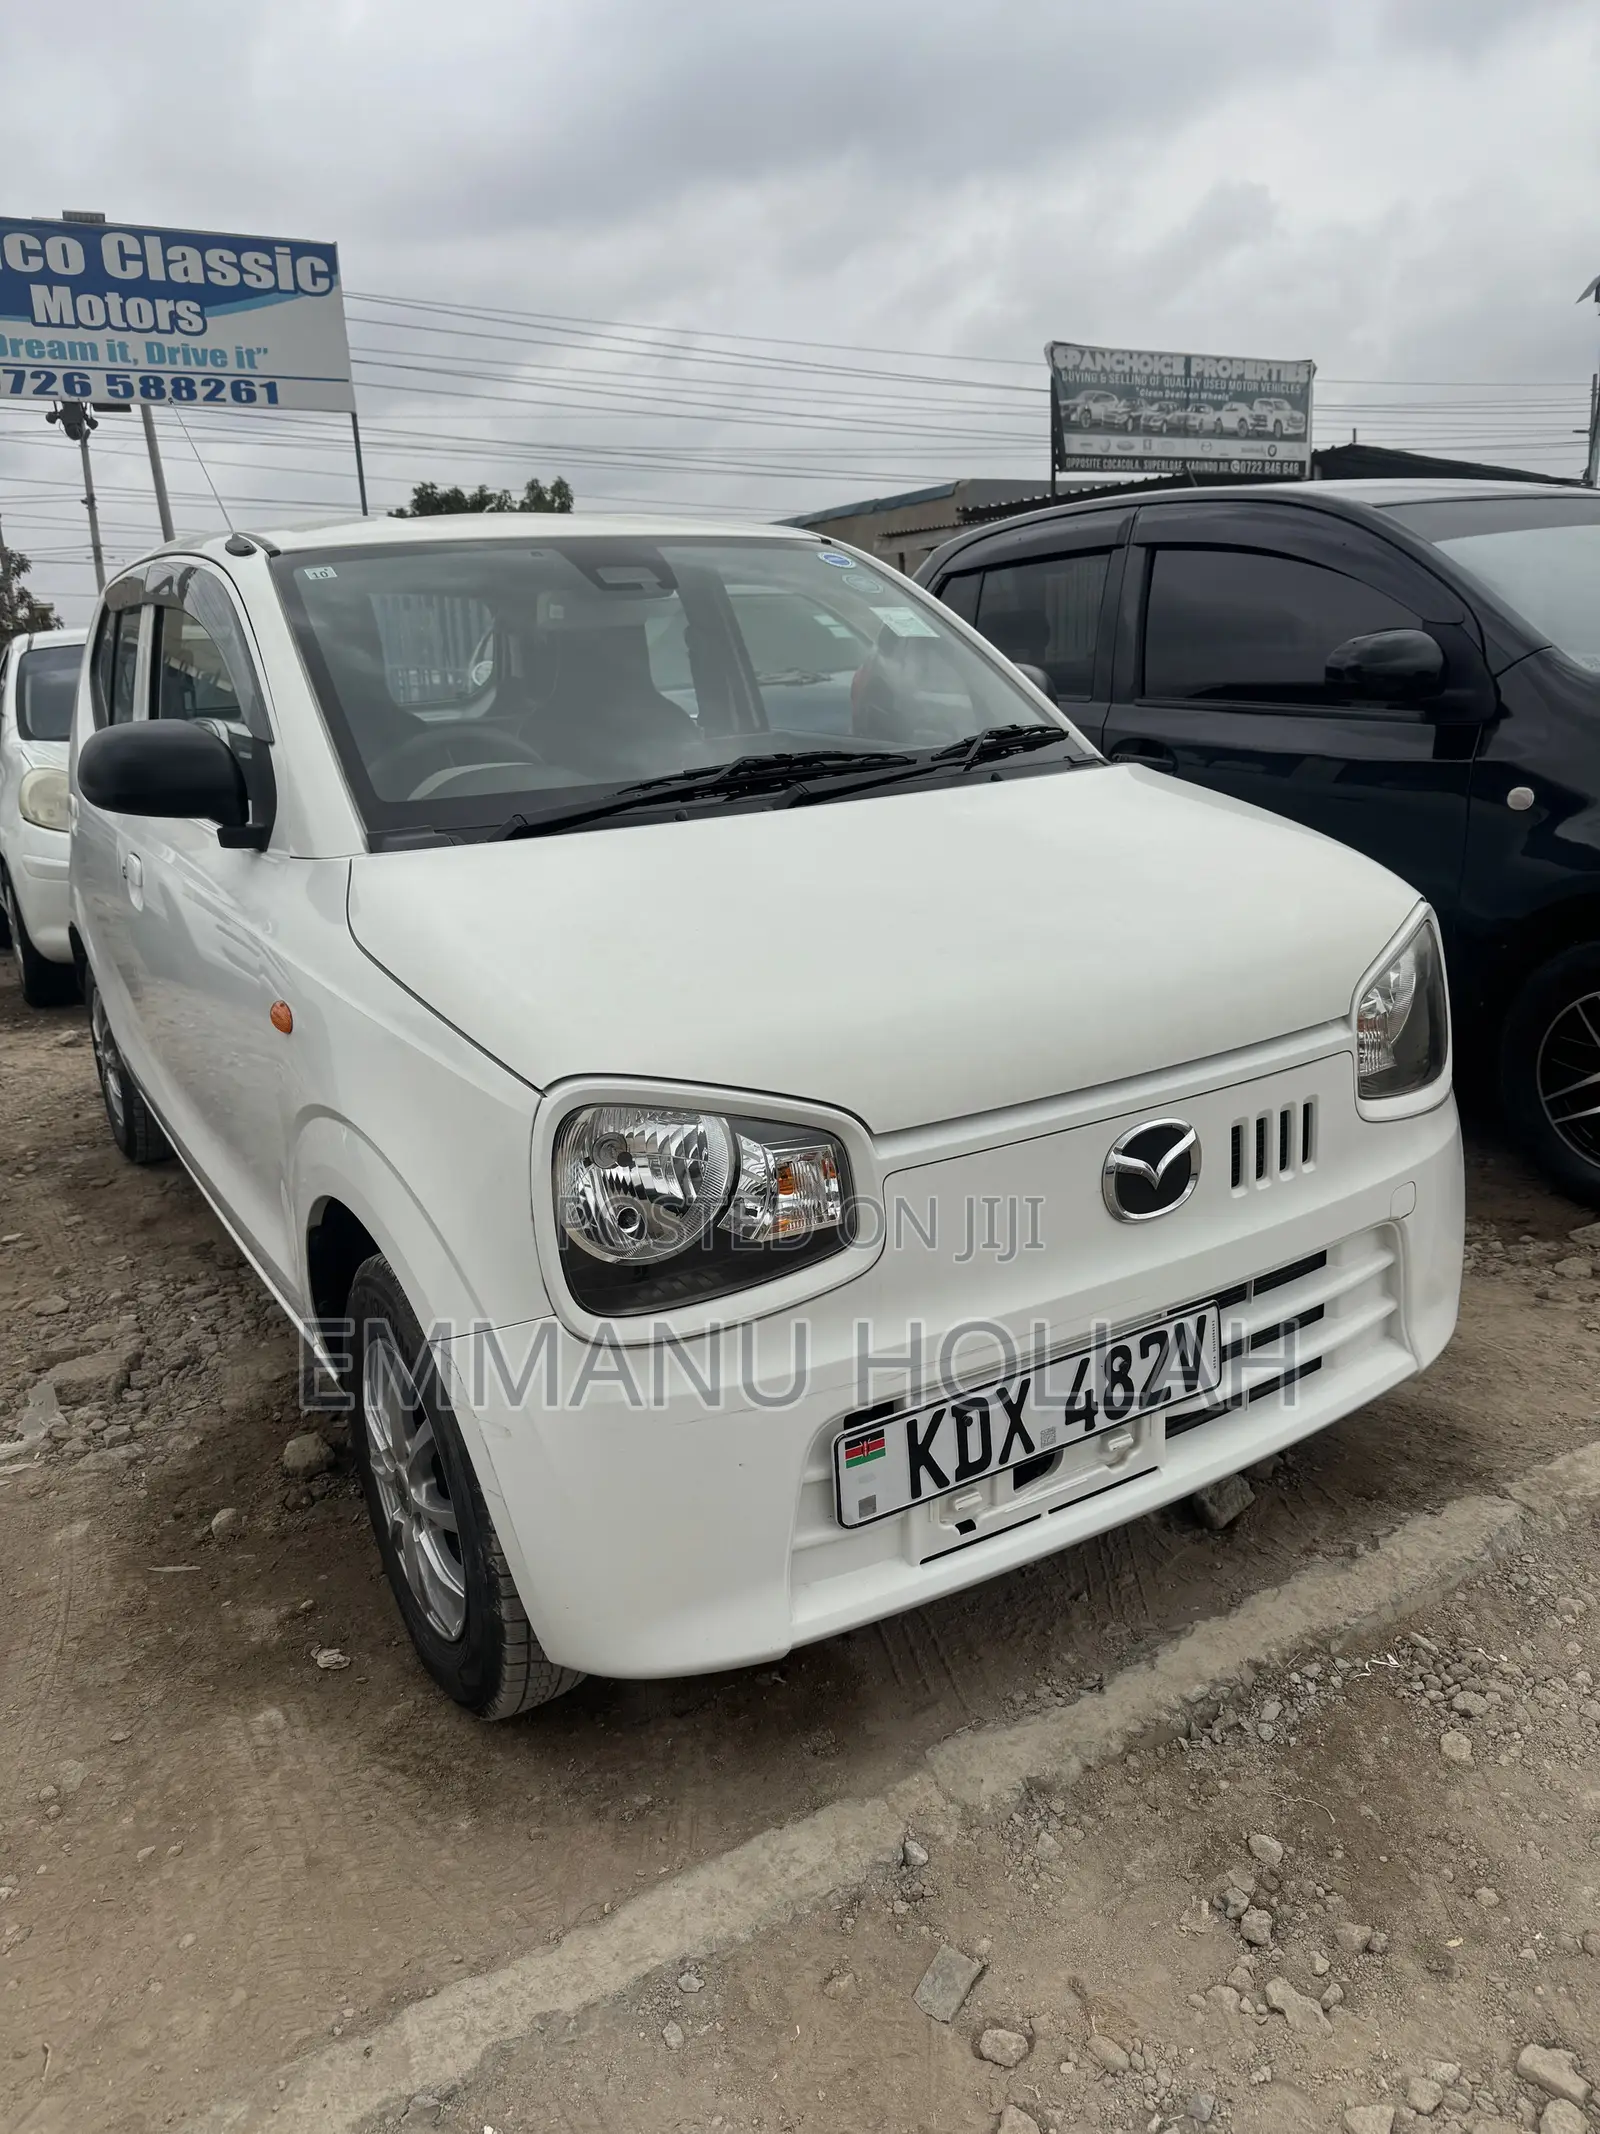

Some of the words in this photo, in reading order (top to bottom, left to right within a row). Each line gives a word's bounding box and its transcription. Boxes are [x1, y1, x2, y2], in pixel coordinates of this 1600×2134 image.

[0, 232, 86, 276] co
[101, 232, 331, 294] Classic
[30, 284, 204, 333] Motors
[106, 338, 139, 366] it,
[146, 341, 228, 369] Drive
[1190, 356, 1310, 383] PROPERTIES
[0, 368, 92, 398] 726
[107, 373, 279, 405] 588261
[1062, 370, 1098, 384] BUYING
[1108, 373, 1147, 386] SELLING
[1149, 375, 1160, 386] OF
[1163, 376, 1201, 389] QUALITY
[1203, 378, 1226, 390] USED
[1228, 379, 1259, 392] MOTOR
[1261, 381, 1301, 395] VEHICLES
[1066, 457, 1101, 469] OPPOSITE
[906, 1377, 1036, 1500] KDX
[1064, 1314, 1207, 1432] 482V
